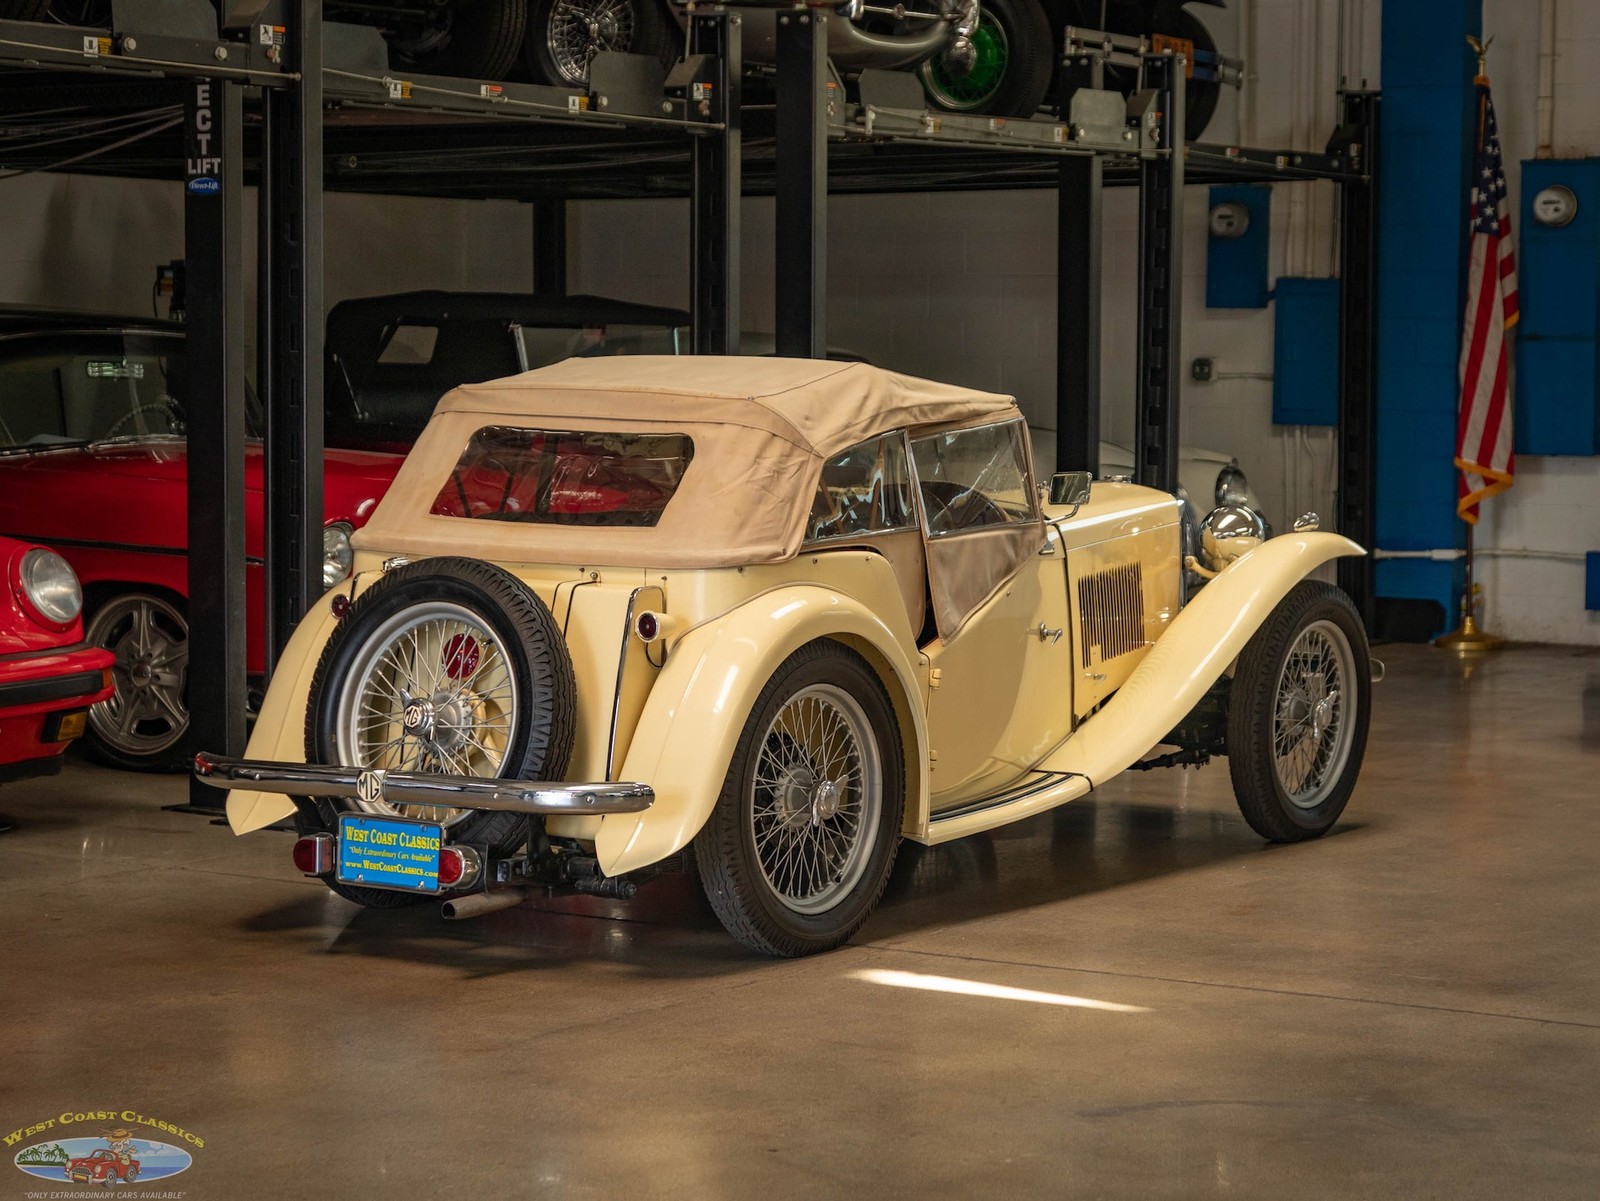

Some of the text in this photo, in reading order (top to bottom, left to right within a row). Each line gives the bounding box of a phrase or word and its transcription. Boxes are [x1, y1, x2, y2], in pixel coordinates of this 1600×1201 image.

[196, 76, 212, 155] ECT
[187, 157, 221, 175] LIFT
[405, 706, 421, 727] MG
[357, 771, 381, 801] MG
